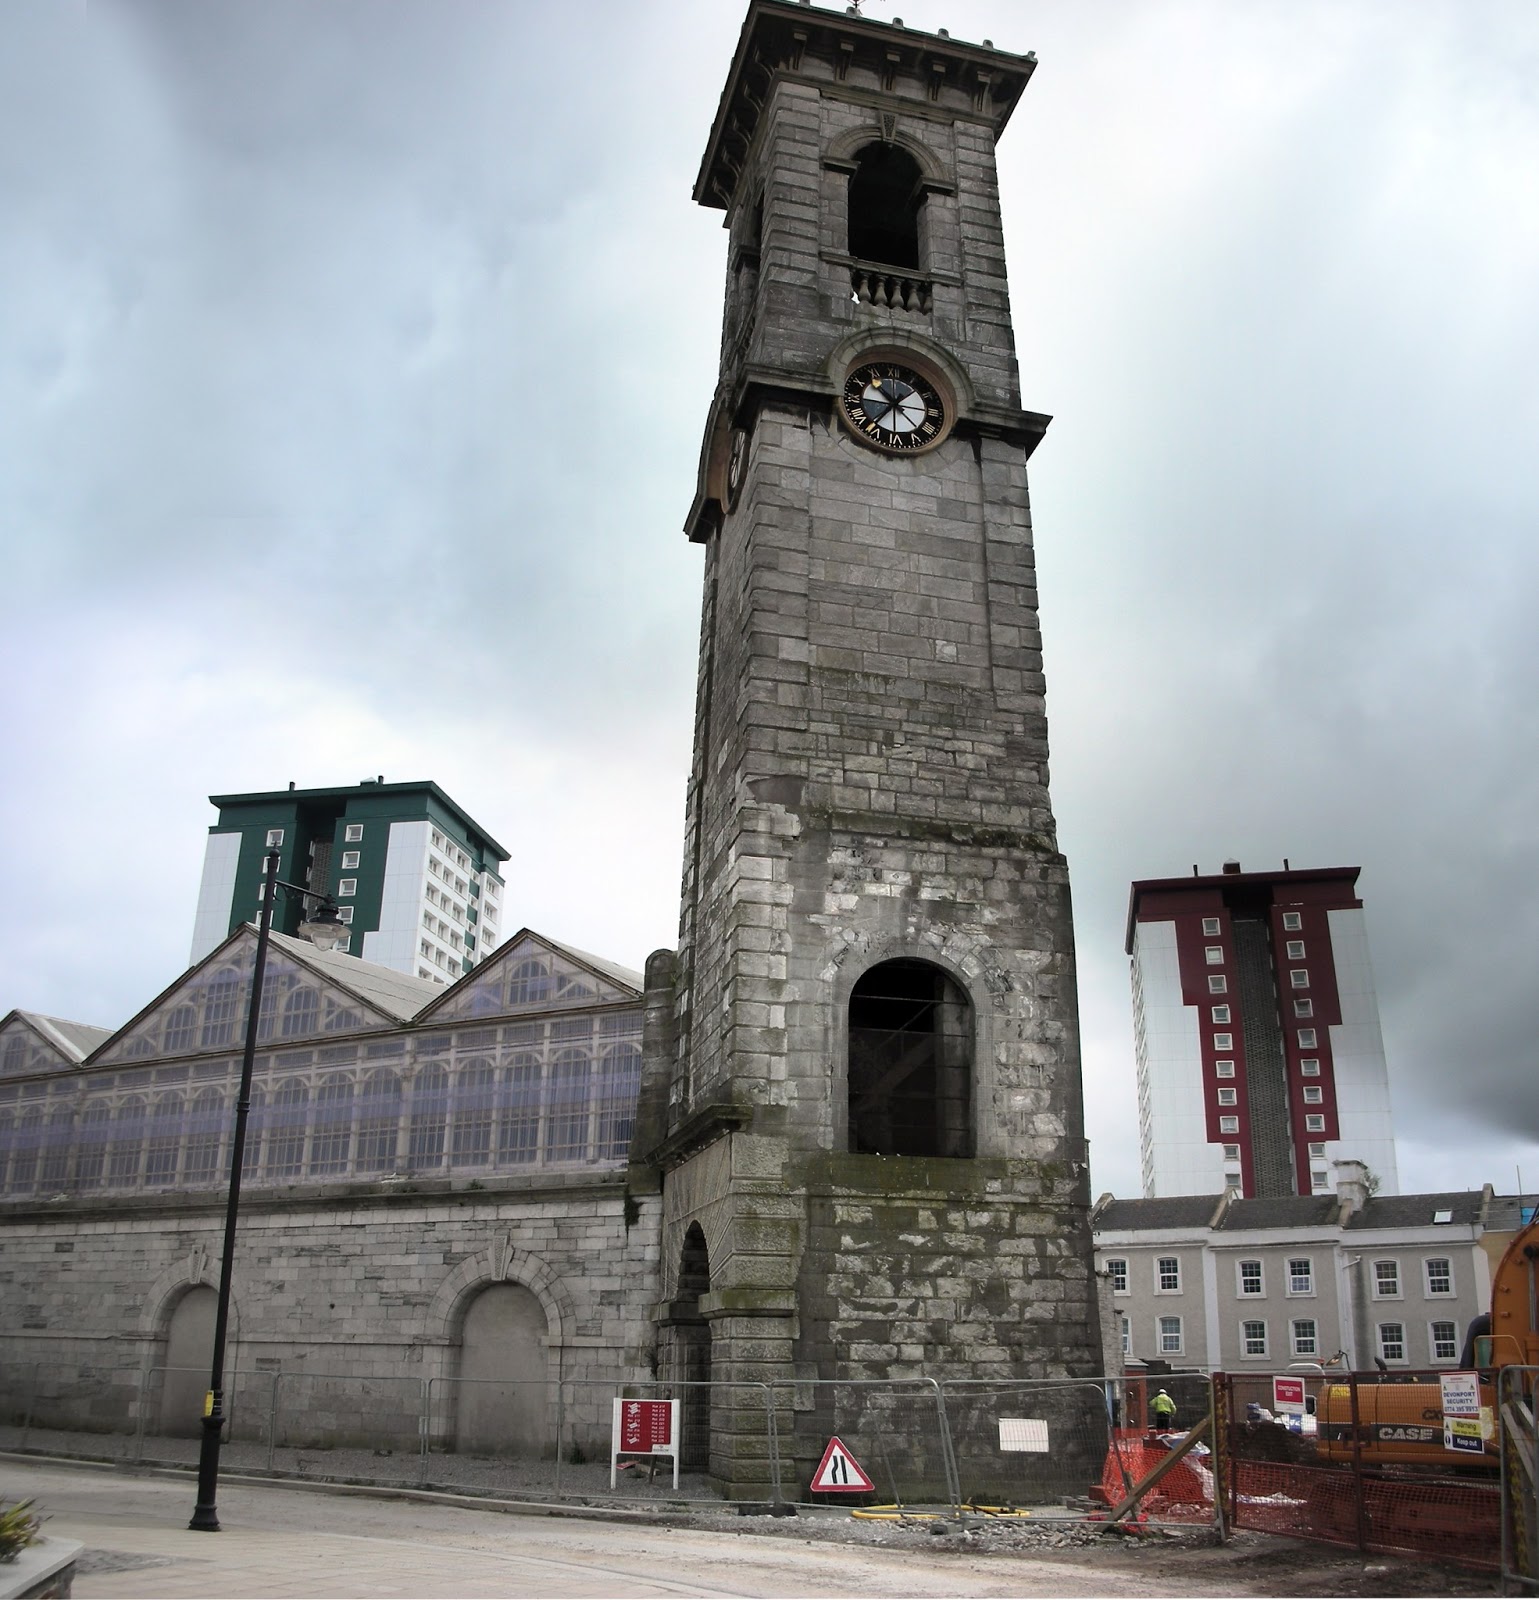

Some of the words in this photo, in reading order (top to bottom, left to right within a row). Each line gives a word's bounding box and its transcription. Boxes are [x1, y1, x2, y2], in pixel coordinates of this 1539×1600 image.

[887, 368, 900, 378] XII
[853, 378, 865, 387] X
[928, 408, 939, 417] III
[890, 434, 902, 445] VI
[911, 433, 921, 444] V
[1456, 1421, 1476, 1431] Warning
[1379, 1428, 1433, 1440] CASE
[1457, 1438, 1468, 1446] Keep
